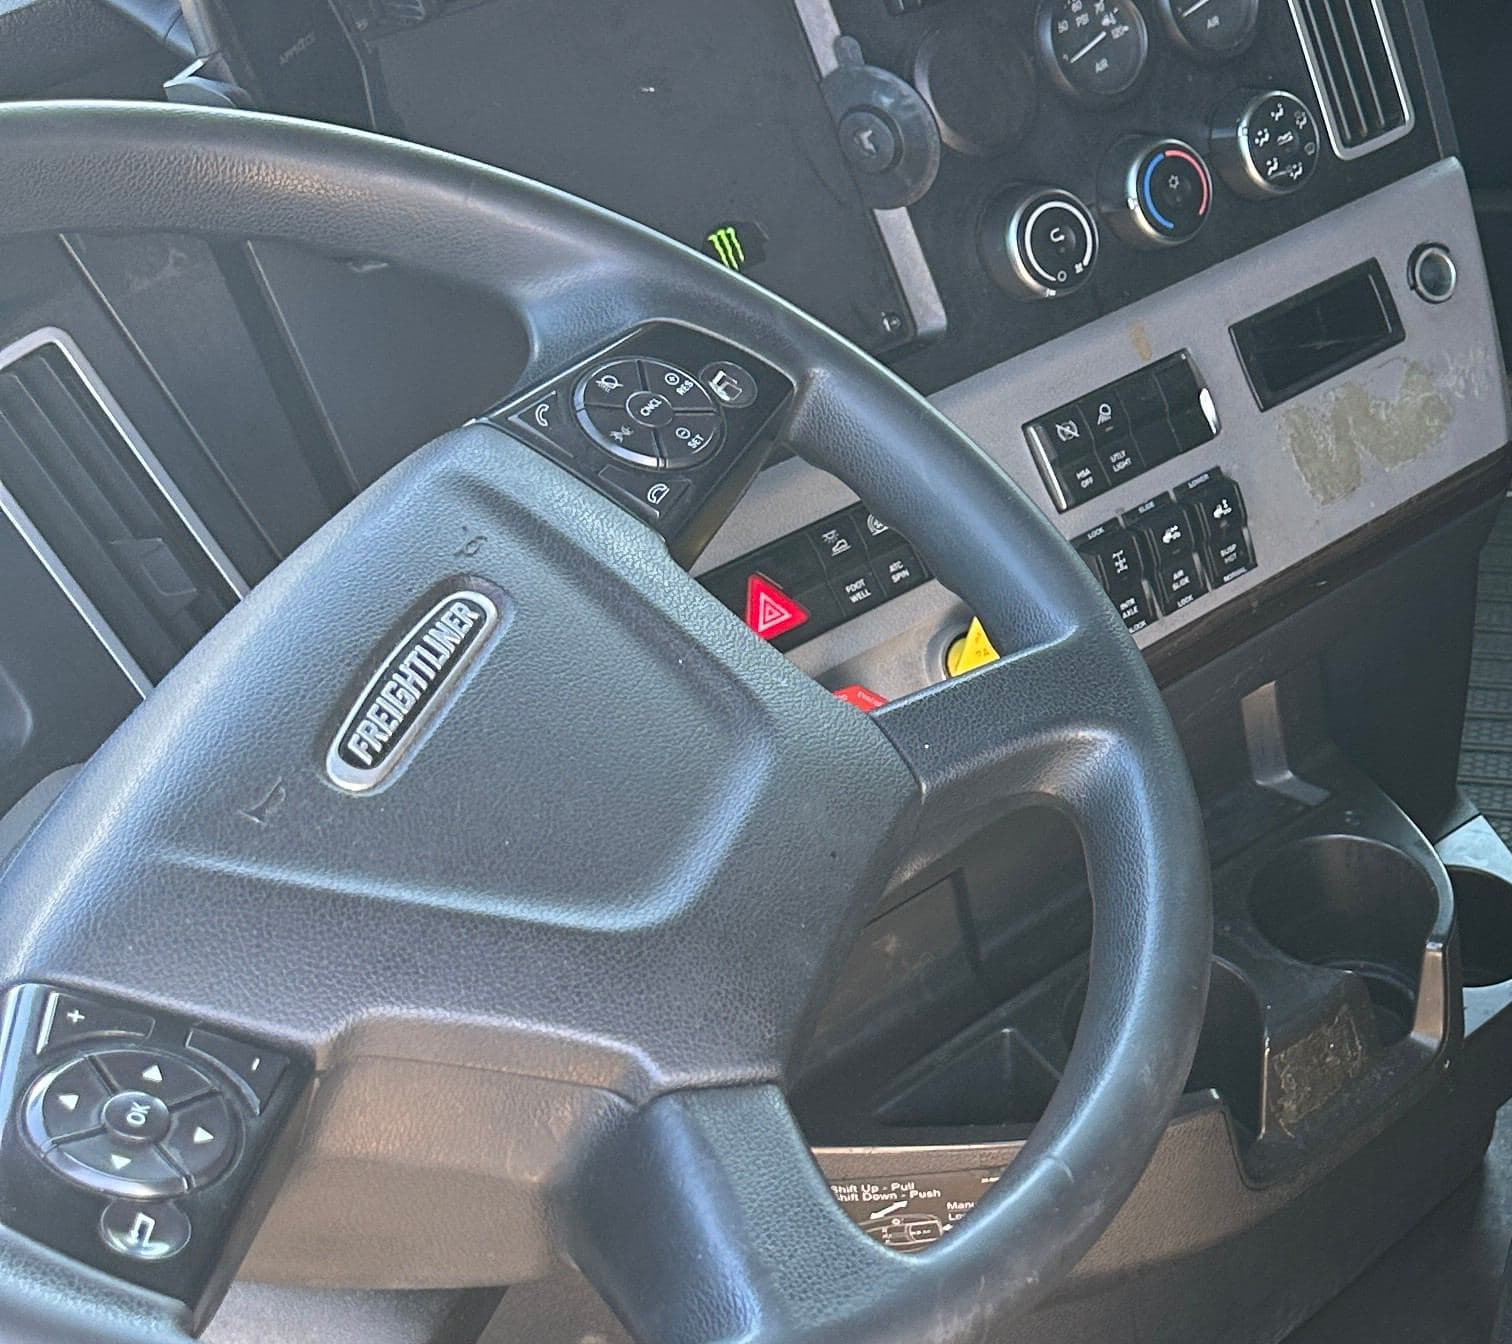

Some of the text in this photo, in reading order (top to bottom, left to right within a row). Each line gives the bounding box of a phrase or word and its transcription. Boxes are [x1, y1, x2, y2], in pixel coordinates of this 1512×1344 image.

[1095, 58, 1109, 73] AIR
[676, 379, 694, 396] RES
[640, 398, 663, 417] CNCL
[687, 433, 704, 449] SET
[1112, 457, 1132, 473] LIGHT
[1081, 476, 1094, 488] OFF
[1187, 473, 1210, 489] LOWER
[1087, 527, 1105, 540] LOCK
[891, 569, 910, 583] SPIN
[1173, 569, 1184, 580] AIR
[845, 578, 866, 594] FOOT
[849, 588, 872, 603] WELL
[1177, 594, 1194, 607] LOCK
[347, 602, 481, 766] FREIGHTLINER
[126, 1101, 151, 1126] OK
[830, 1184, 858, 1194] Shift
[861, 1184, 879, 1194] Up
[891, 1182, 915, 1191] Pull
[862, 1192, 898, 1201] Down
[909, 1189, 941, 1199] Push
